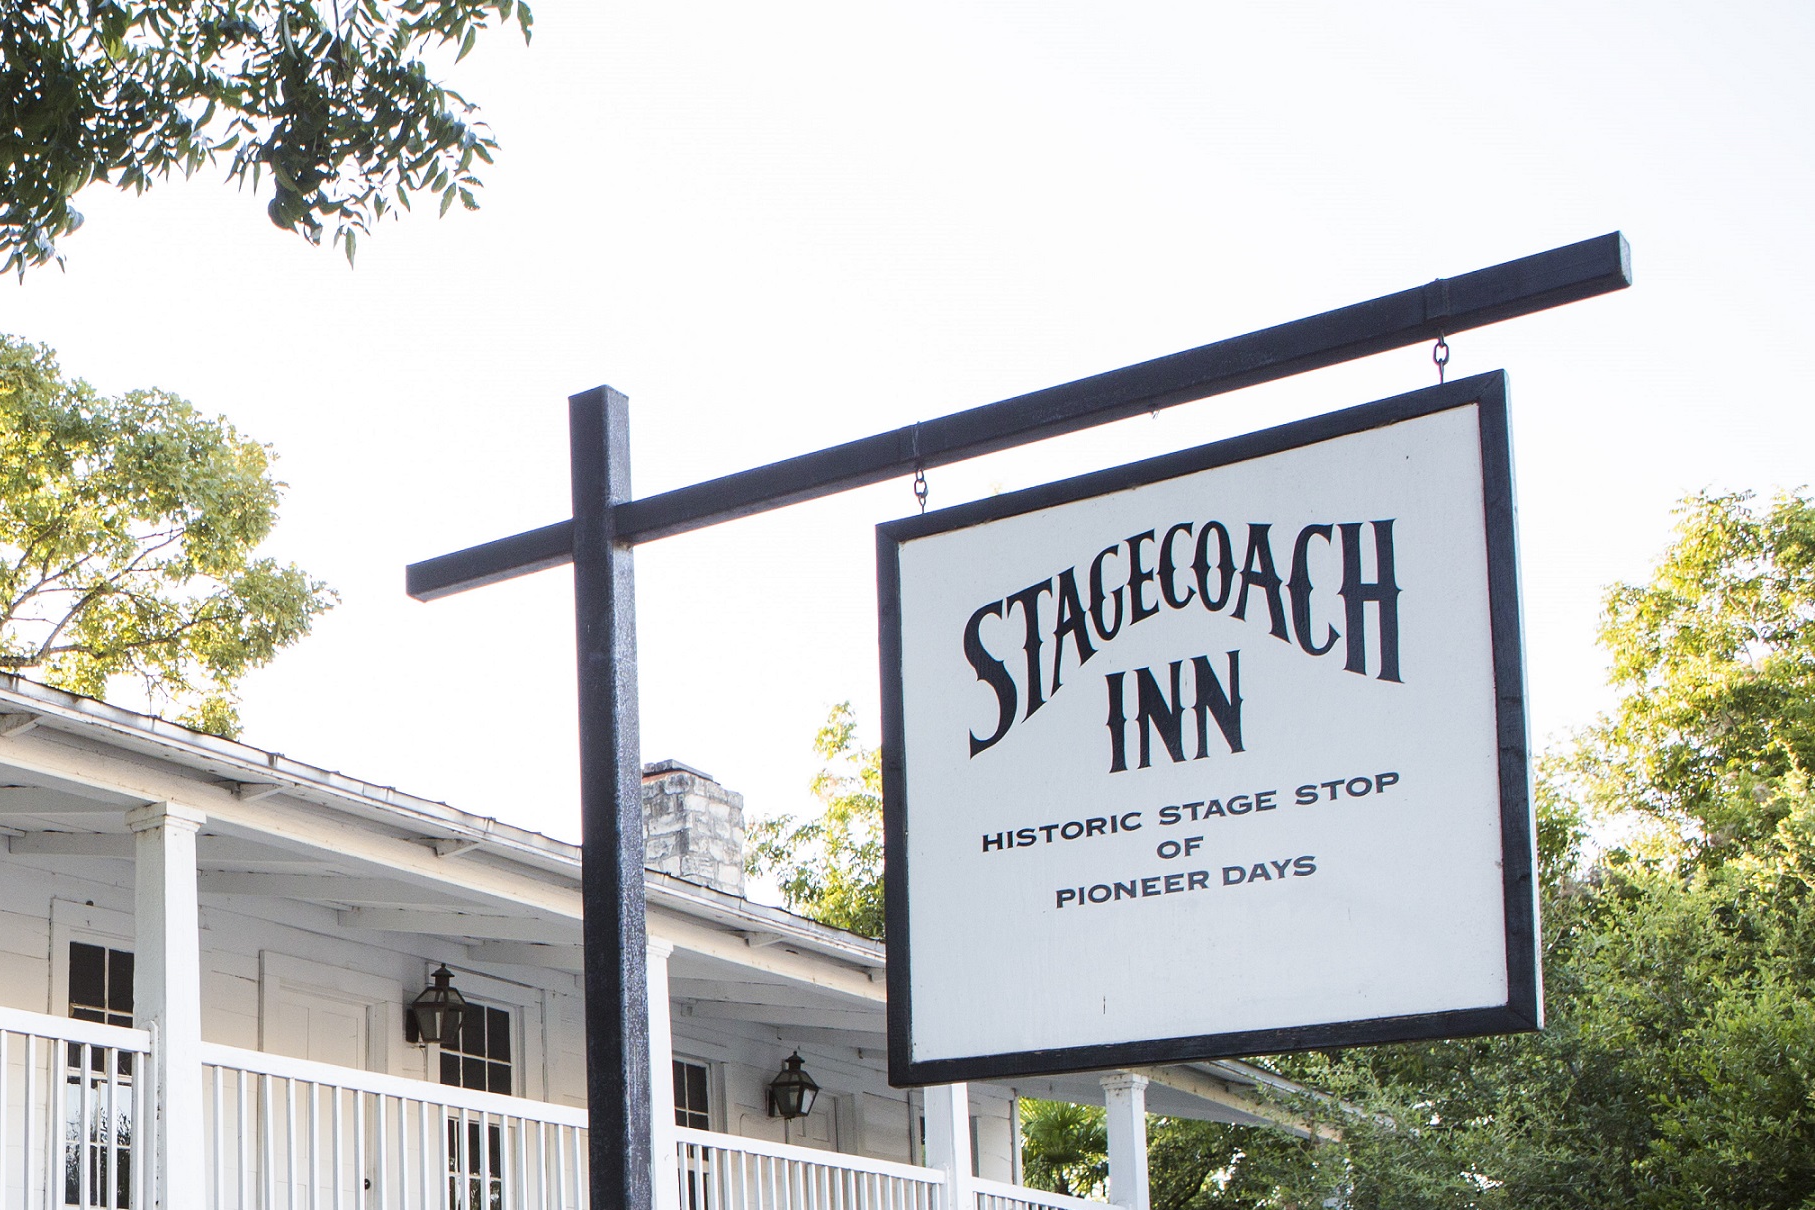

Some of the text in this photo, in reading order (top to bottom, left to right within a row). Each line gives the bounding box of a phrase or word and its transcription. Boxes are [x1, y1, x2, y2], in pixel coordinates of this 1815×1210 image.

[963, 518, 1405, 760] STAGECOACH
[1104, 649, 1246, 774] INN
[981, 772, 1401, 853] HISTORIC STAGE STOP
[1156, 835, 1205, 860] OF
[1055, 855, 1318, 909] PIONEER DAYS
